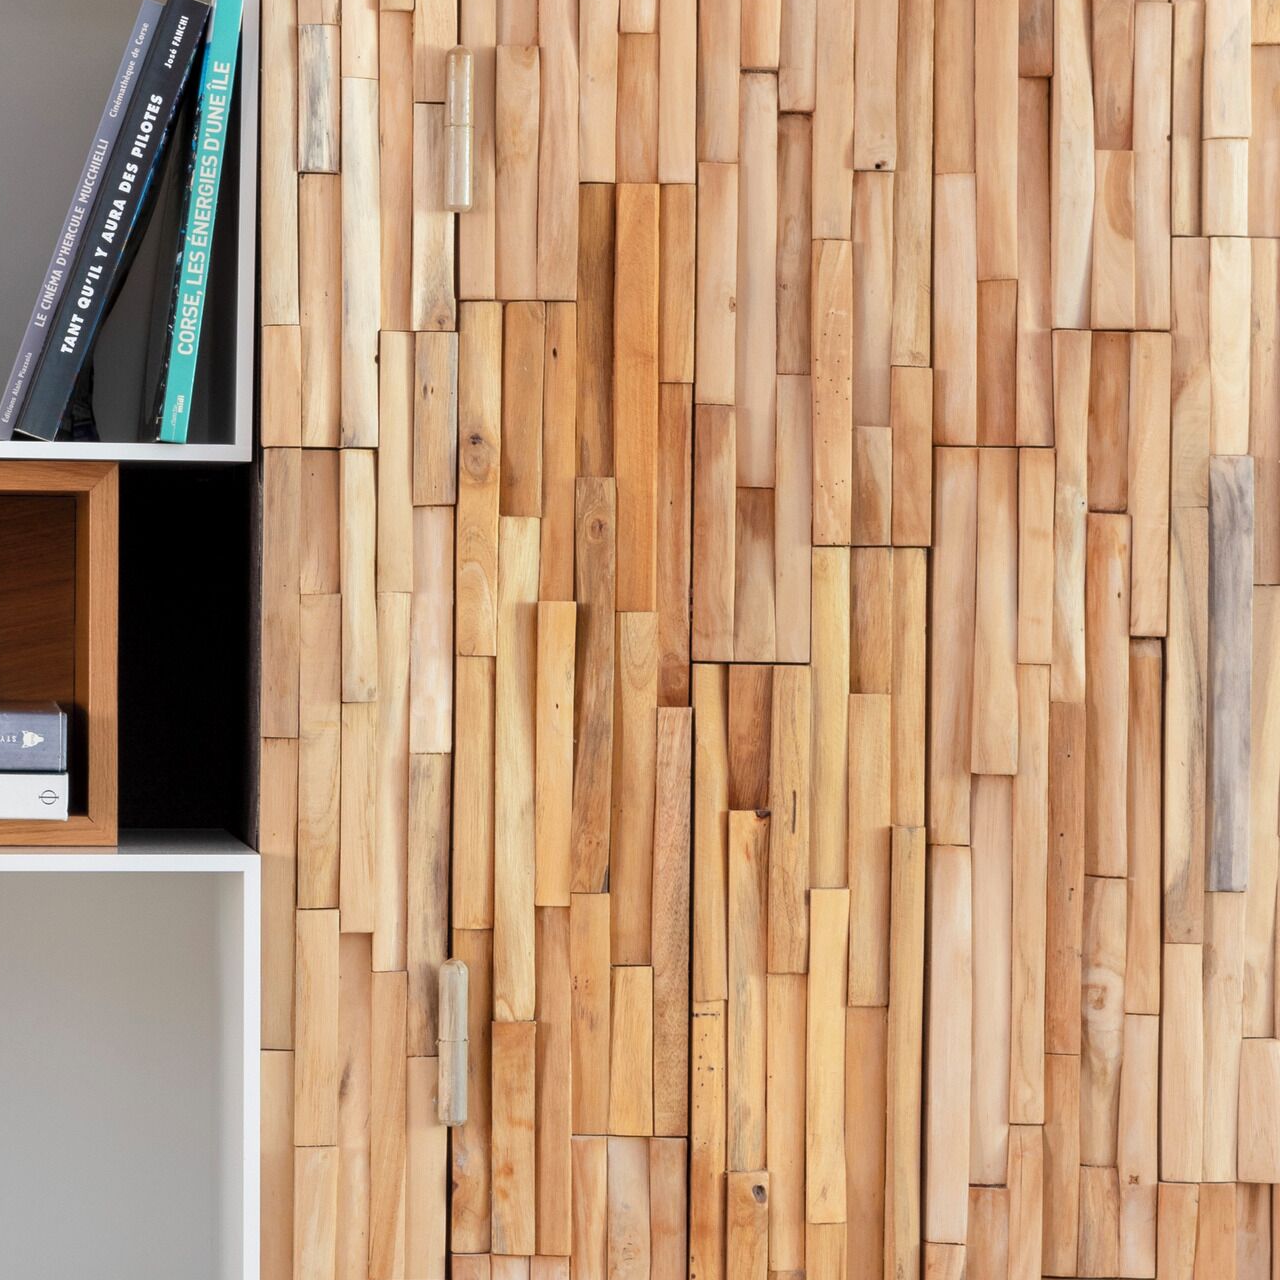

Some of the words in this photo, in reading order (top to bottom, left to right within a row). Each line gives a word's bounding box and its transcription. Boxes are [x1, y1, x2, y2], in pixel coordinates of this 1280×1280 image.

[134, 22, 149, 45] Corse
[163, 48, 178, 70] José
[172, 15, 190, 47] FANCHI
[130, 47, 140, 59] de
[109, 60, 136, 118] Cinémathèque
[205, 61, 231, 91] ÎLE
[203, 95, 226, 152] D'UNE
[78, 138, 110, 204] MUCCHIELLI
[186, 154, 219, 248] ÉNERGIES
[55, 205, 86, 267] D'HERCULE
[60, 313, 84, 354] TANT
[77, 264, 103, 310] QU'IL
[94, 246, 108, 259] Y
[101, 198, 127, 244] AURA
[118, 162, 139, 194] DES
[131, 93, 163, 159] PILOTES
[186, 252, 206, 286] LES
[40, 269, 63, 311] CINÉMA
[34, 313, 47, 328] LE
[177, 290, 202, 356] CORSE,
[17, 352, 33, 379] Piazzola
[11, 377, 24, 397] Alain
[176, 394, 185, 413] midi
[1, 396, 17, 423] Éditions
